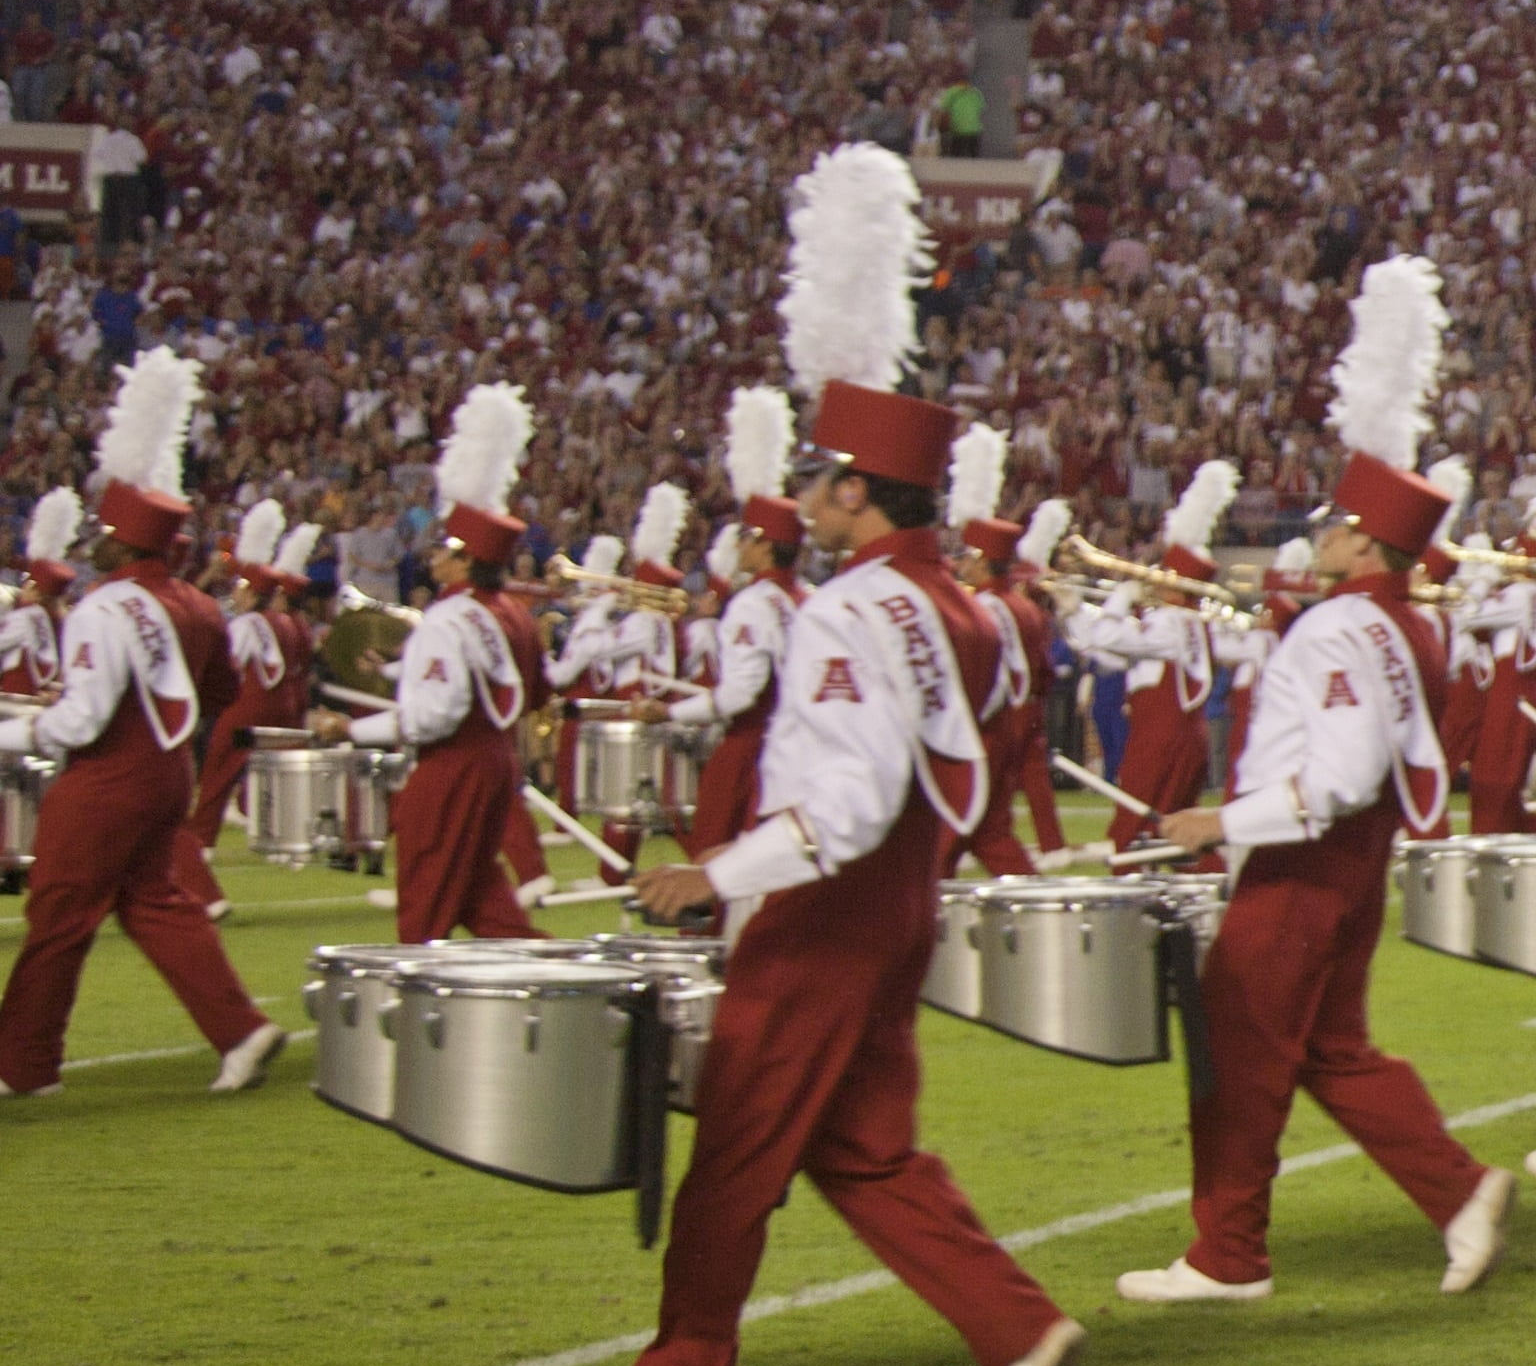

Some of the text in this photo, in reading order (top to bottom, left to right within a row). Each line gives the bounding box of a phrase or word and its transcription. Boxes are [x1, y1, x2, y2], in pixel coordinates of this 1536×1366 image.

[24, 163, 70, 194] LL
[733, 624, 755, 646] A
[71, 642, 95, 671] A
[424, 657, 448, 682] A
[877, 594, 948, 719] BAMA
[1362, 621, 1414, 723] BAMA
[811, 657, 866, 703] A
[1322, 669, 1361, 709] A
